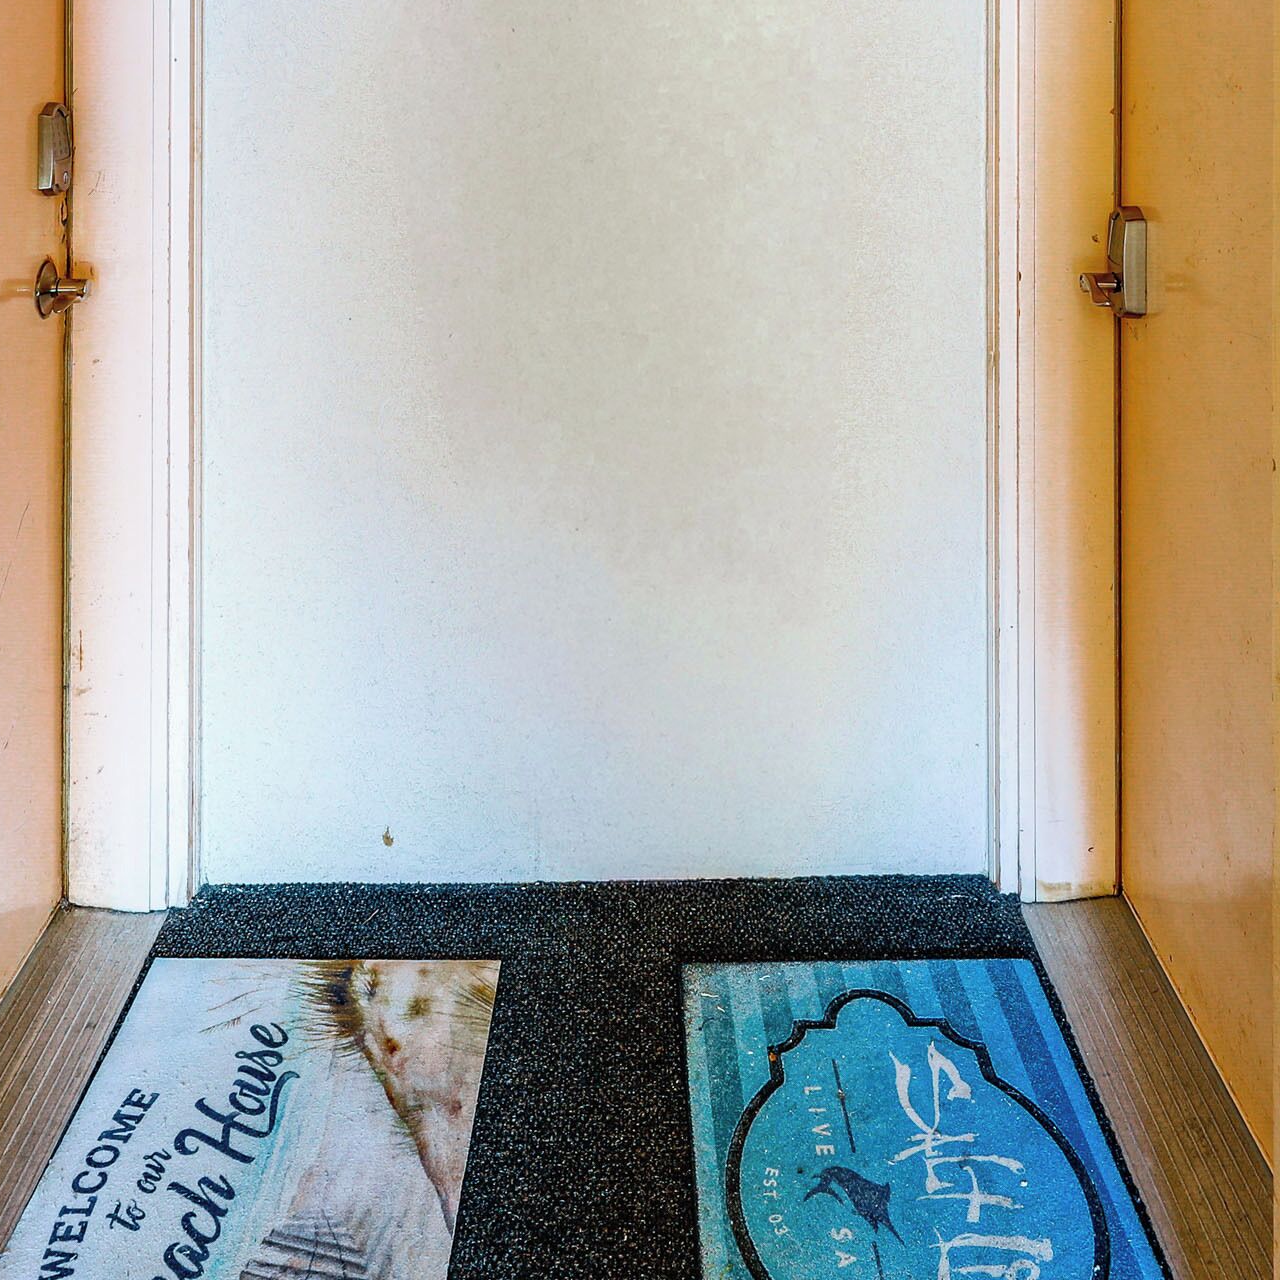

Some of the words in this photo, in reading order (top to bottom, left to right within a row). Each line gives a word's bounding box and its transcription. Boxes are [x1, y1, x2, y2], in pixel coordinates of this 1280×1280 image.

[173, 1021, 300, 1164] House
[803, 1085, 835, 1157] LIVE
[39, 1088, 159, 1280] WELCOME
[106, 1199, 145, 1232] to
[136, 1147, 172, 1195] our
[150, 1174, 236, 1280] ach
